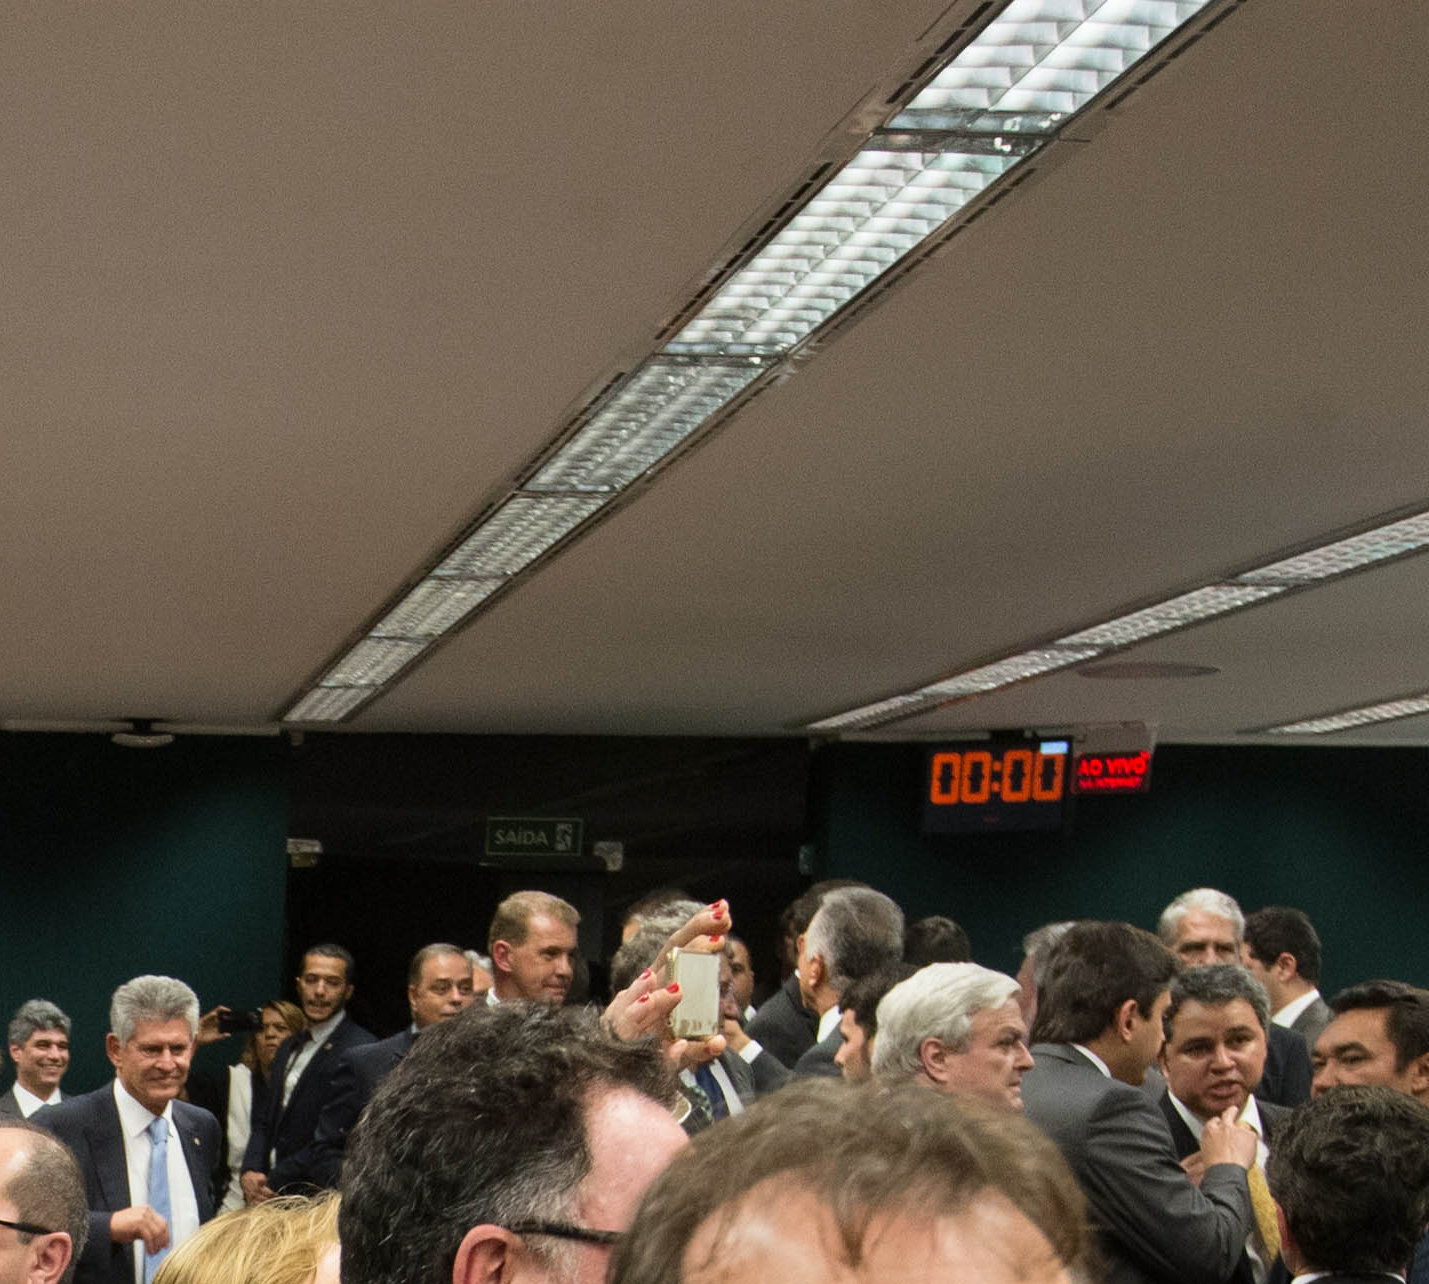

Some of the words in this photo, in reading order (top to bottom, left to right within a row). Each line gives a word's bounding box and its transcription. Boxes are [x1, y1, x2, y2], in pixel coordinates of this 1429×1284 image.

[1078, 758, 1103, 776] AO
[1106, 756, 1147, 776] VIVO
[930, 749, 1065, 805] 00:00
[494, 826, 550, 847] SAÍDA
